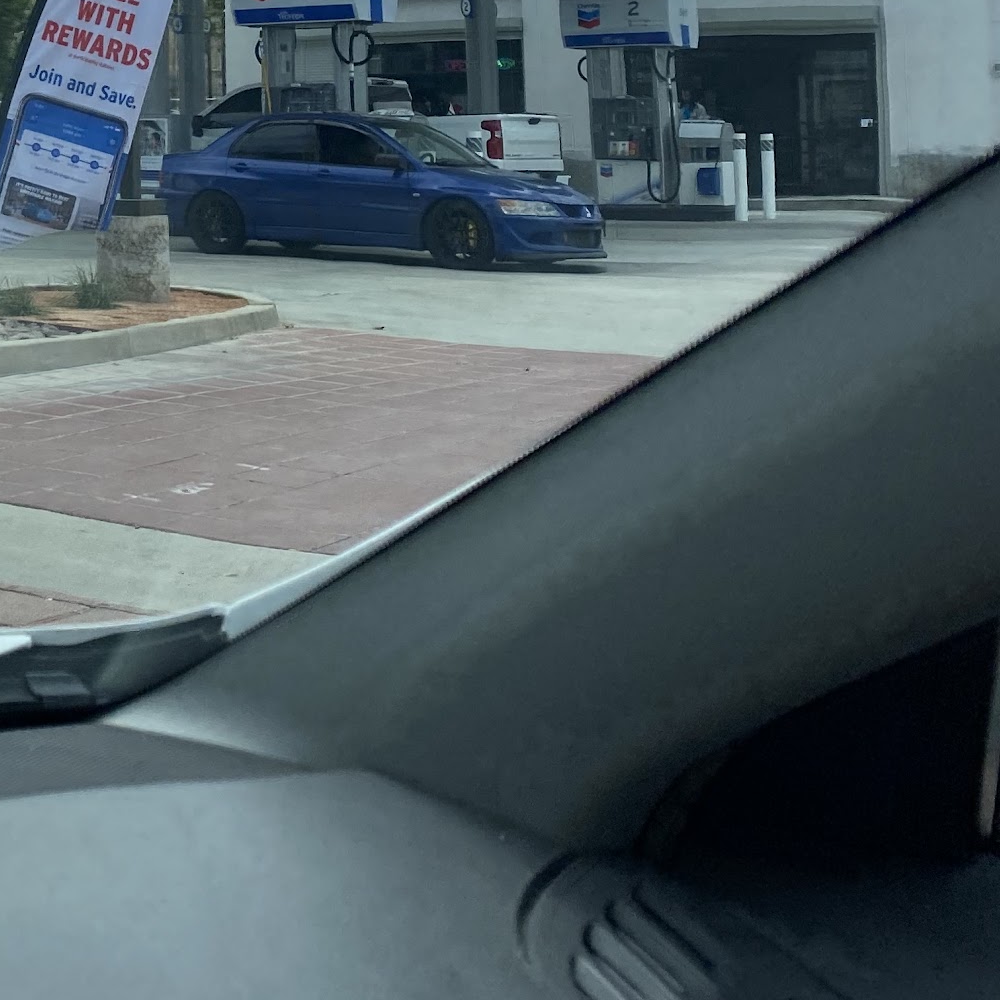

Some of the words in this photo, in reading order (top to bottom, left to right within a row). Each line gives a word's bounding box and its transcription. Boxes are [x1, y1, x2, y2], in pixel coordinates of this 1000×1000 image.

[78, 0, 136, 35] WITH
[463, 2, 469, 12] 2
[627, 1, 639, 16] 2
[41, 20, 152, 70] REWARDS
[29, 64, 63, 87] Join
[66, 78, 97, 97] and
[99, 84, 136, 109] Save.
